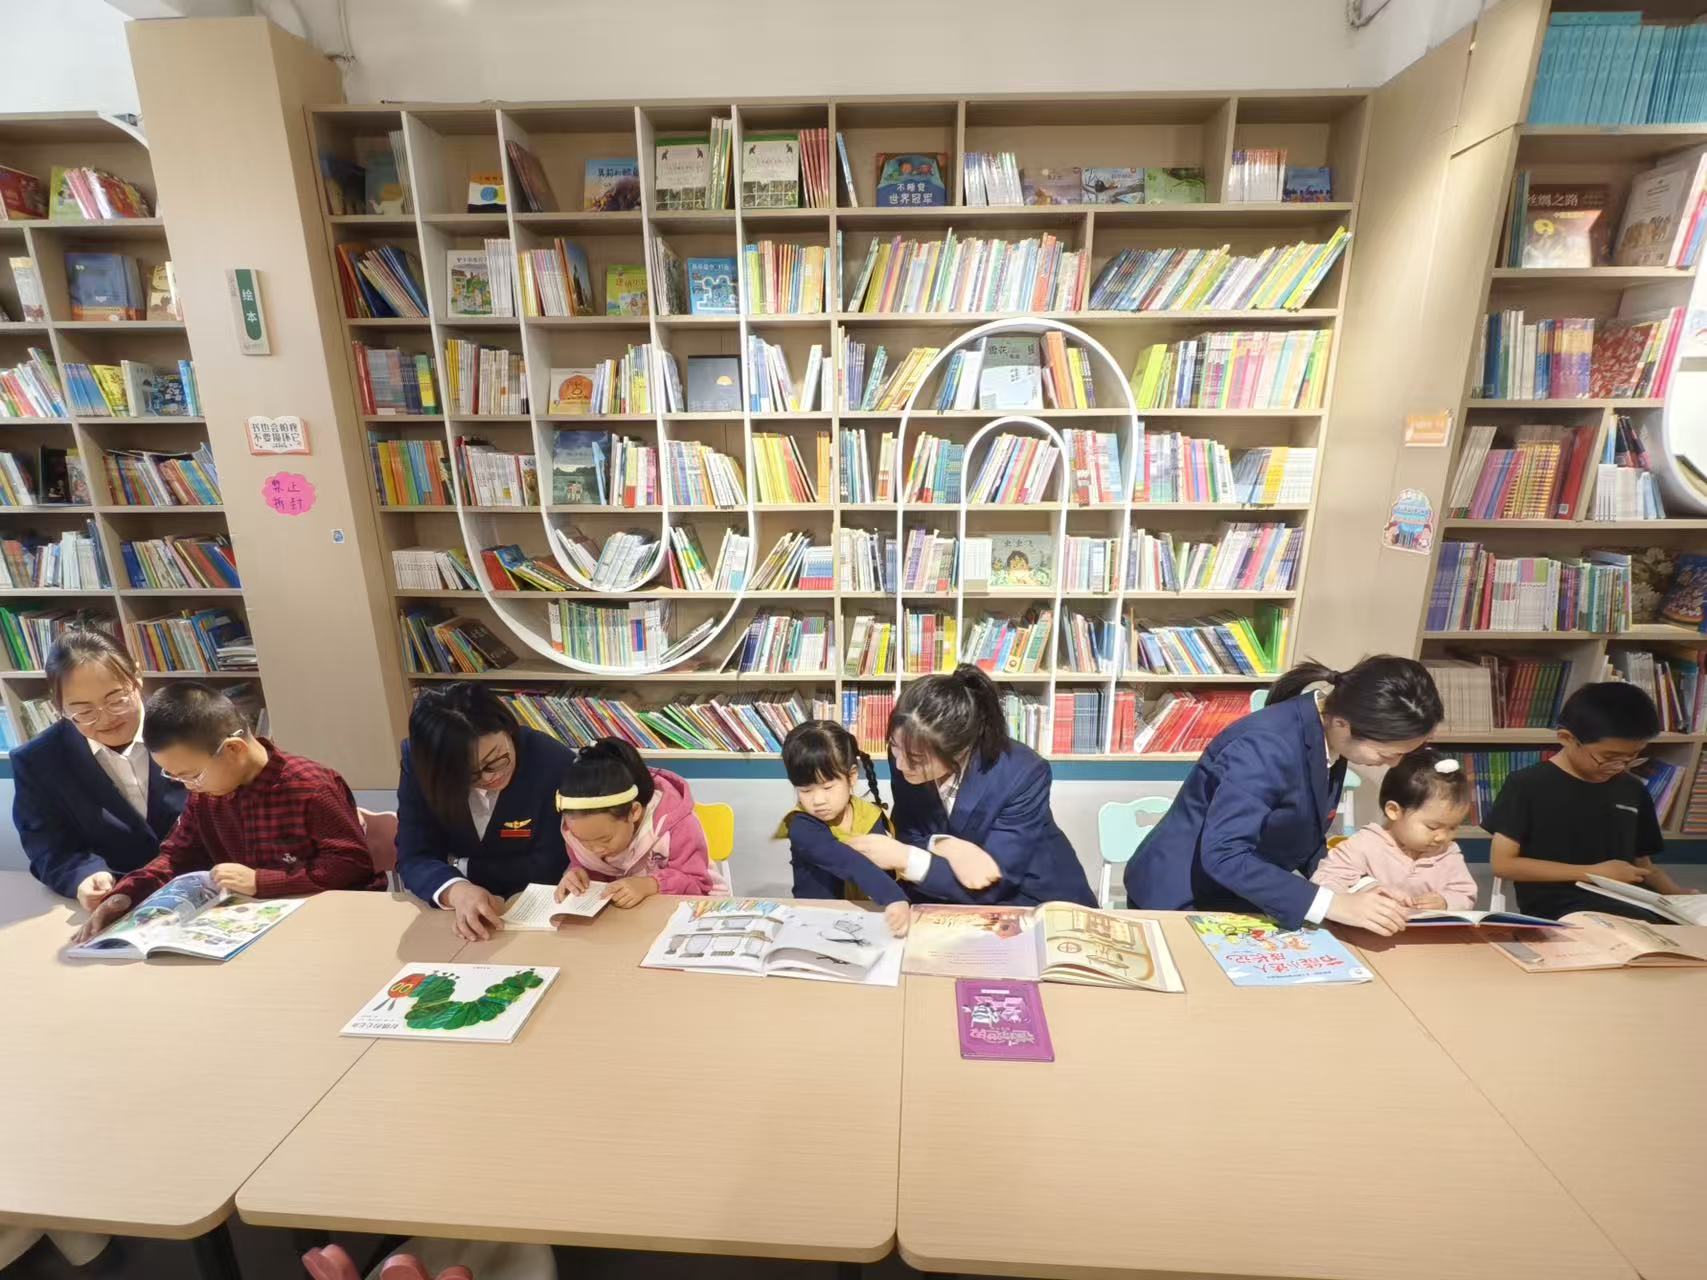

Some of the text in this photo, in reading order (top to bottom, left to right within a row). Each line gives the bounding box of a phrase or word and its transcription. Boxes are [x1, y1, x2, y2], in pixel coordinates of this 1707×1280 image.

[889, 193, 934, 205] 世界冠军
[1527, 193, 1579, 207] 丝绸之路
[241, 288, 258, 323] 绘本
